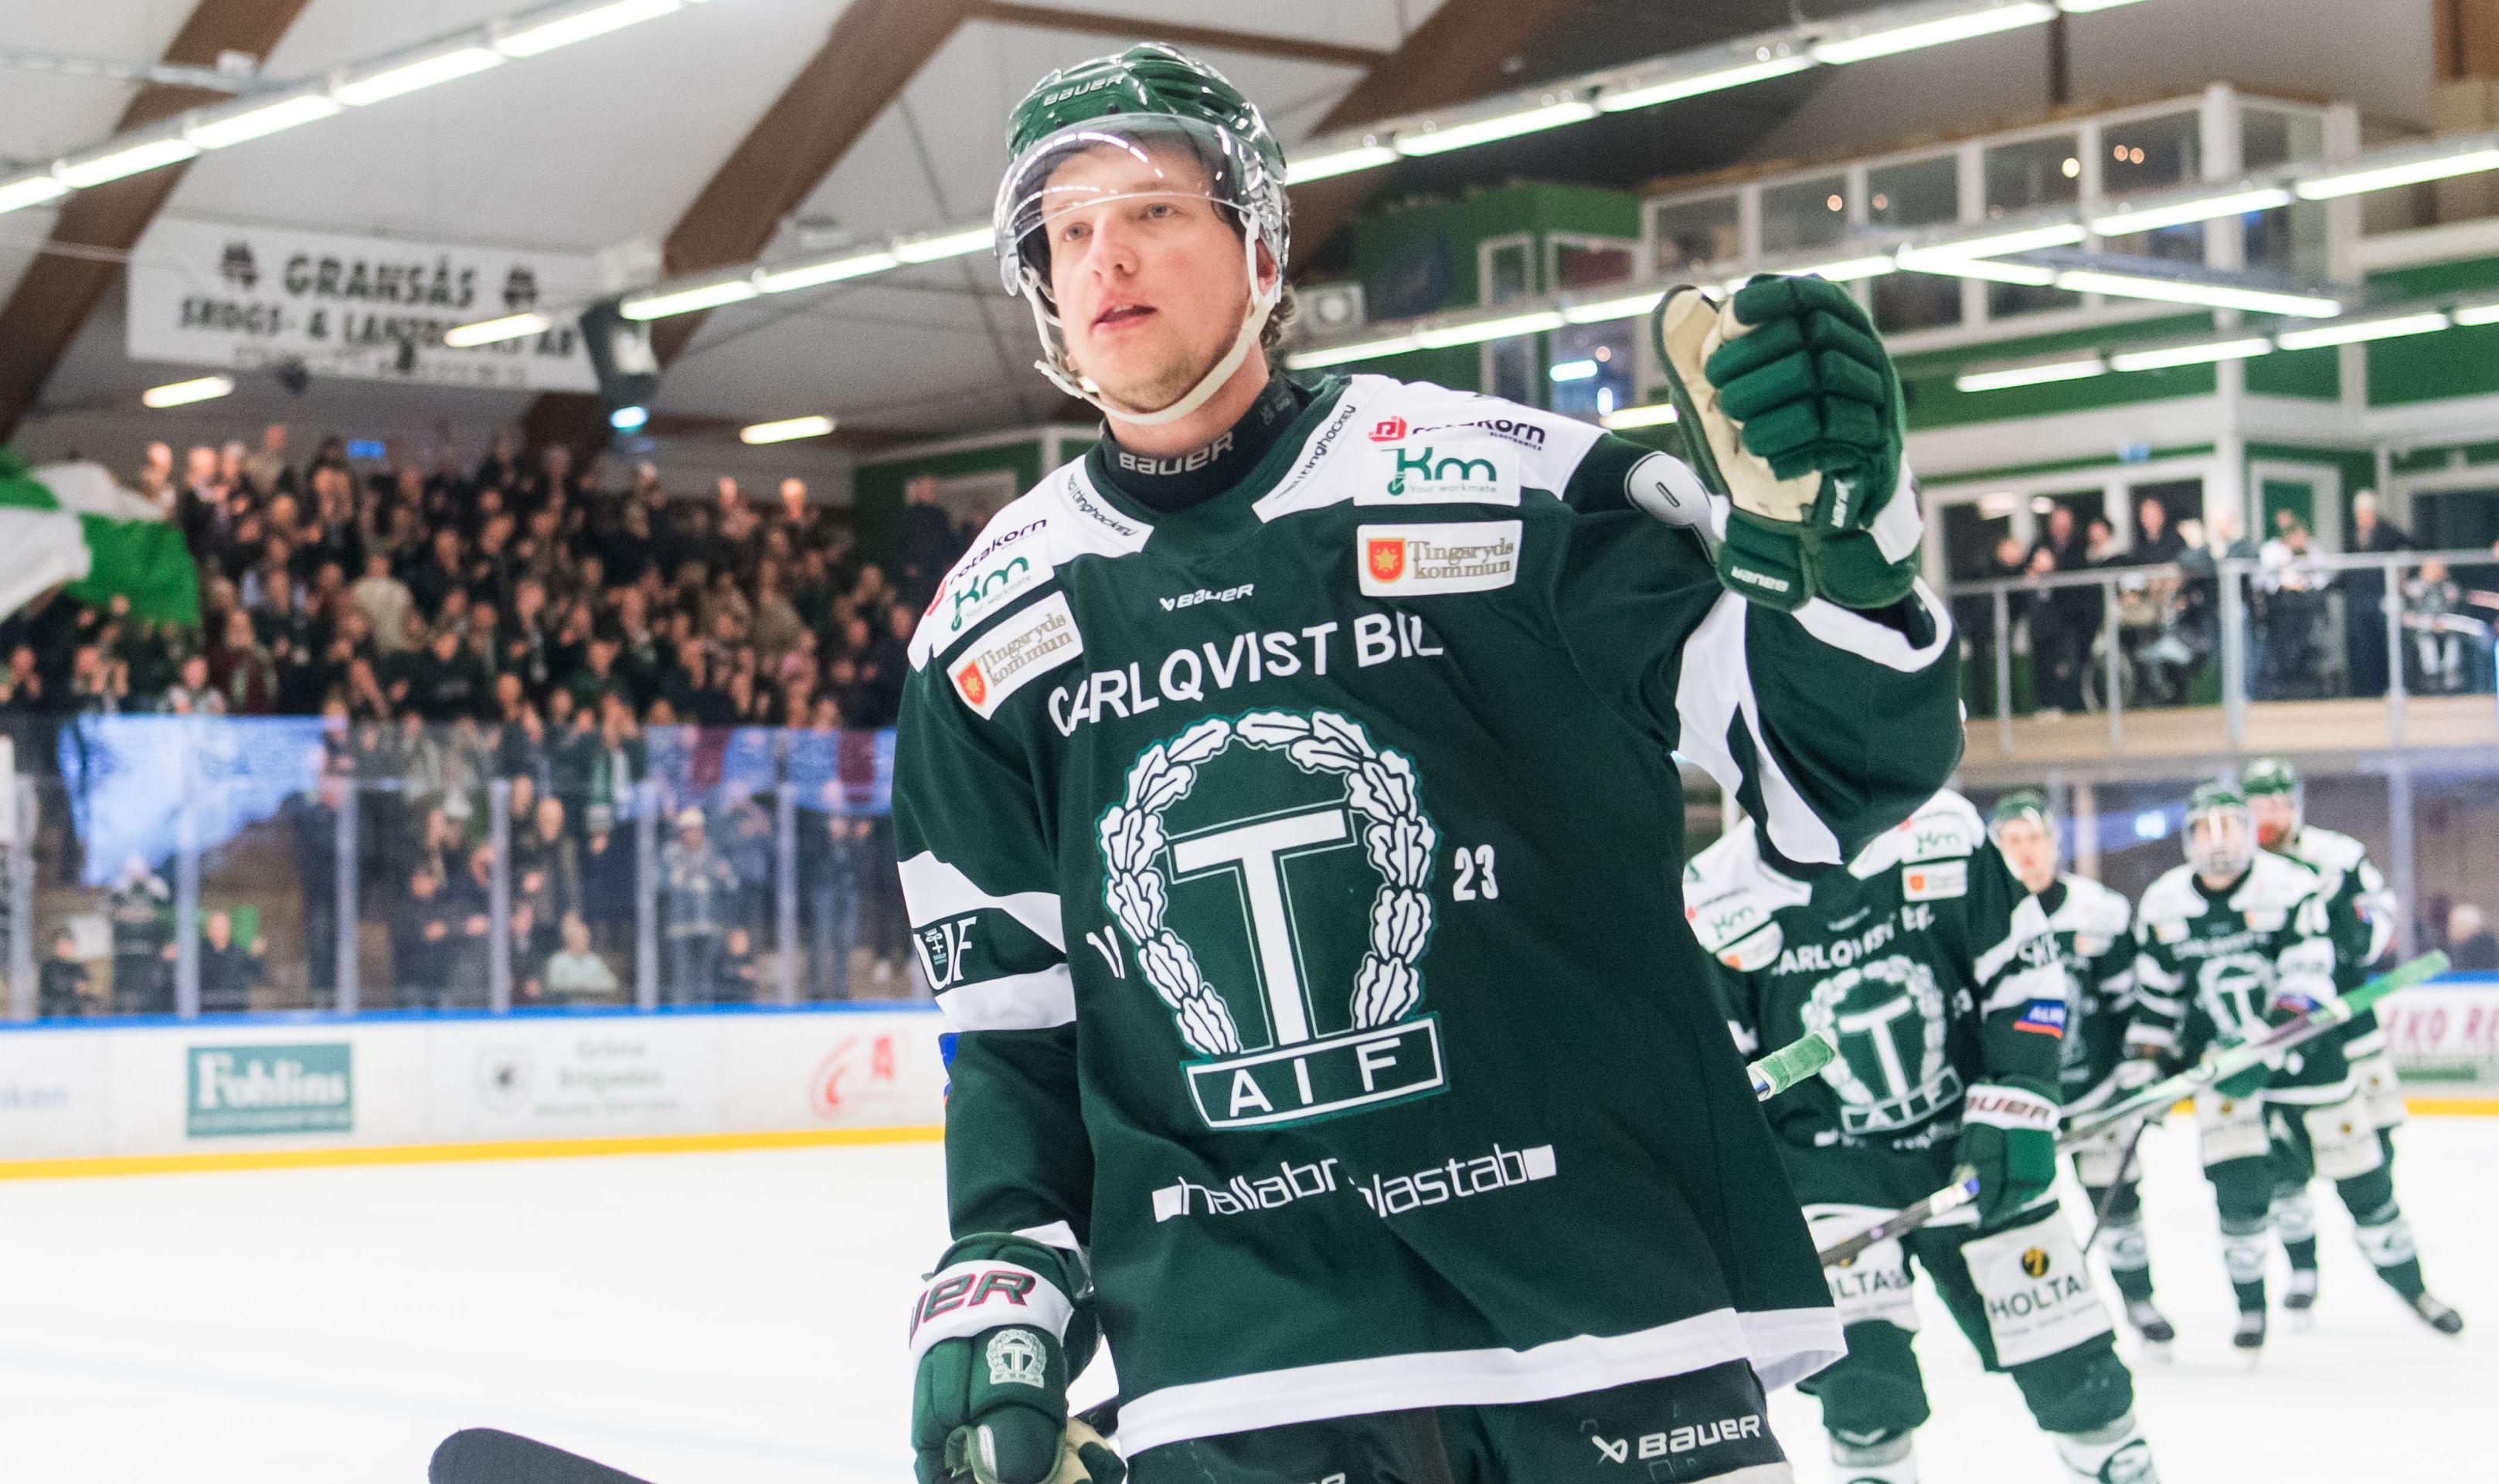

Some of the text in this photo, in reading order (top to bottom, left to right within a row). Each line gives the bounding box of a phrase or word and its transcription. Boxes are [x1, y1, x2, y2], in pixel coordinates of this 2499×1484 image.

[1044, 73, 1125, 107] BAUER
[1119, 430, 1234, 476] BAUER
[1439, 482, 1497, 494] workmate
[950, 519, 1047, 586] rotakorn
[1407, 538, 1515, 565] Tingsryds
[1413, 559, 1511, 579] kommun
[1177, 583, 1254, 609] BAUER
[978, 612, 1067, 674] Tingsryds
[989, 630, 1073, 688] kommun
[1048, 610, 1444, 738] CARLQVIST BIL
[1452, 844, 1499, 902] 23
[1173, 808, 1348, 1047] T
[1638, 1414, 1761, 1460] BAUER
